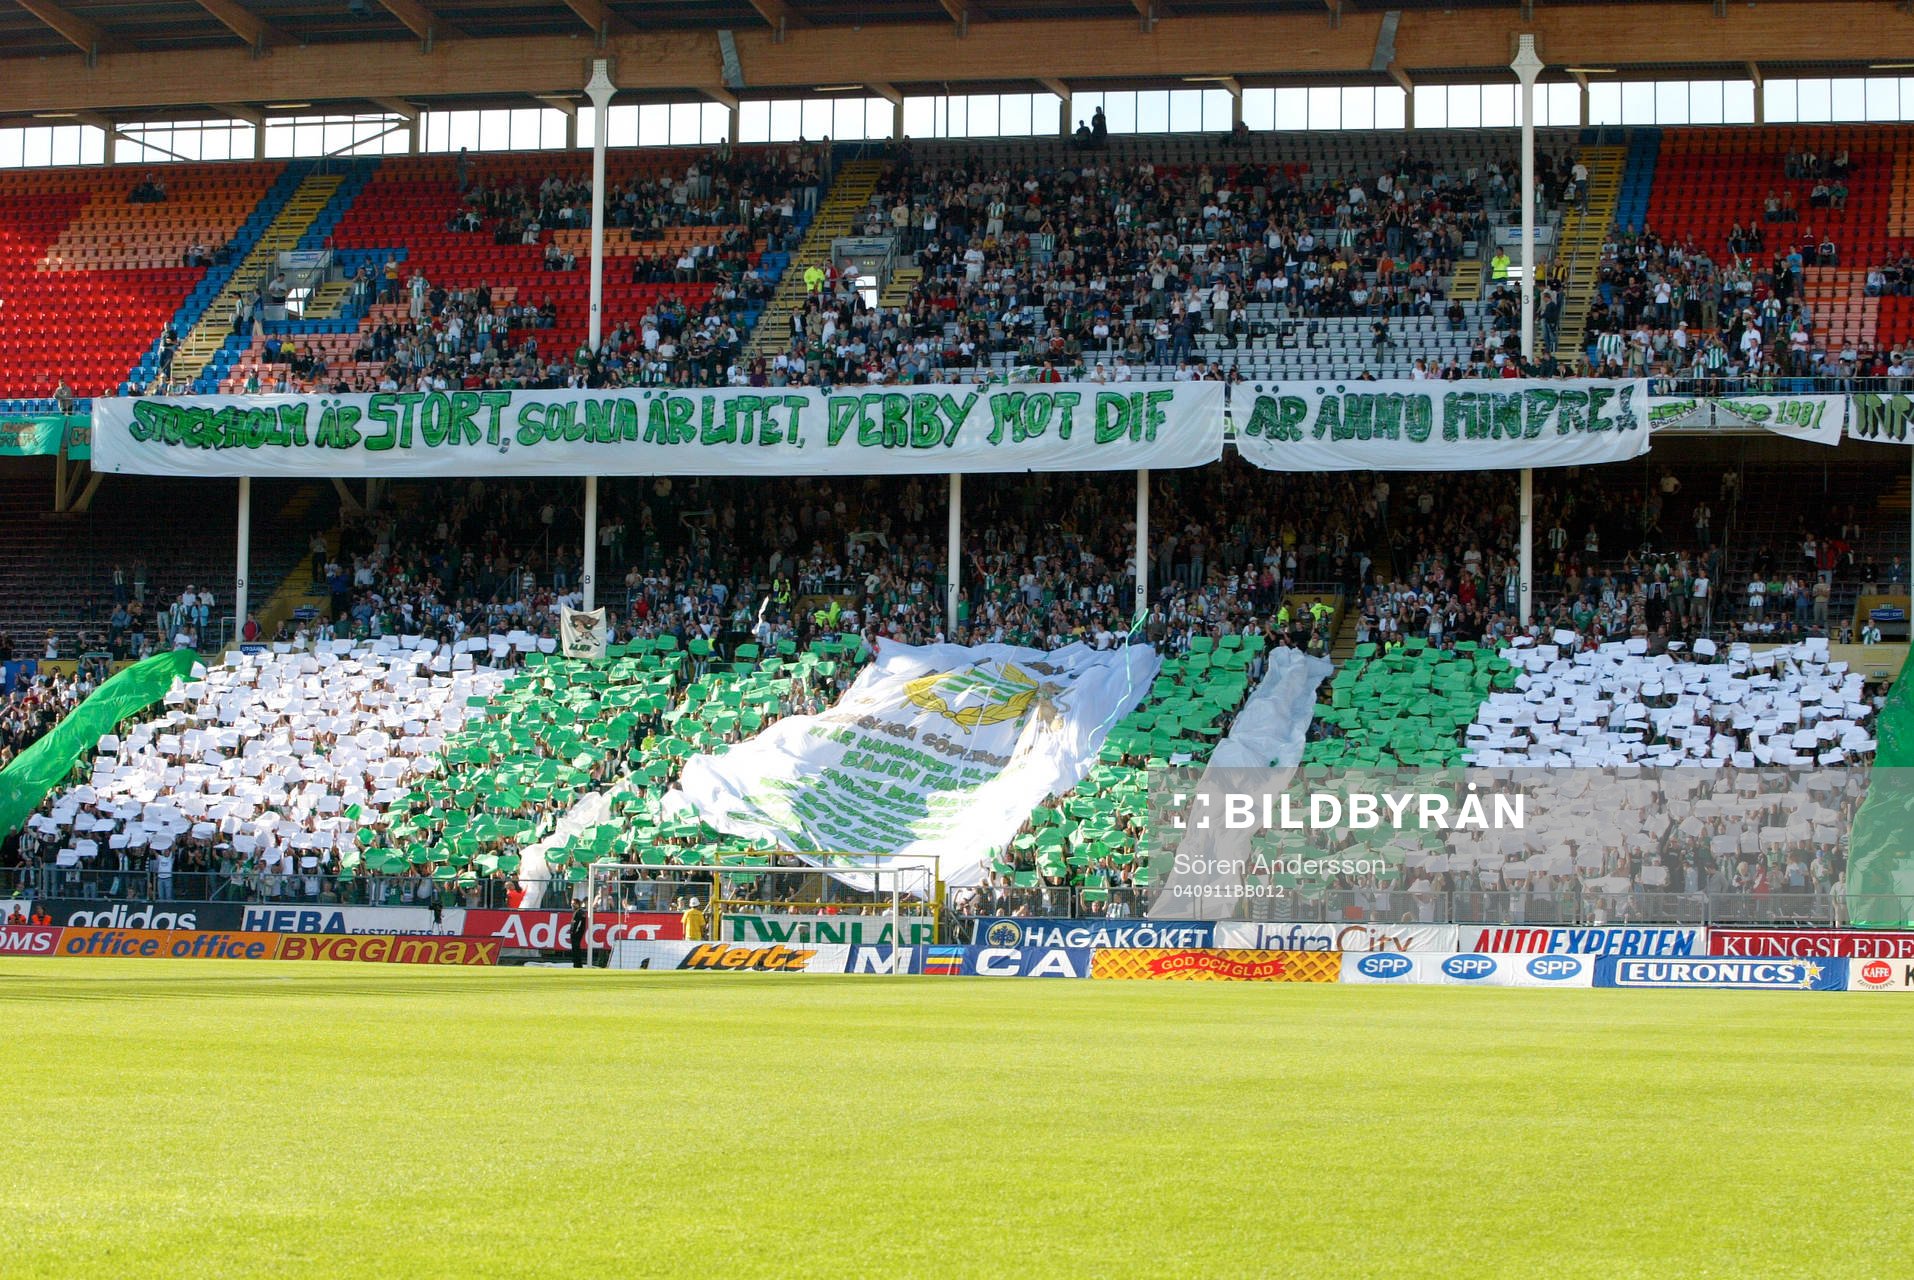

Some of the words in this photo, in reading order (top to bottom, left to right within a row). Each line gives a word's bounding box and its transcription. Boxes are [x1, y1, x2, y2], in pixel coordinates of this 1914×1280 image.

[1523, 294, 1530, 305] 3
[129, 399, 309, 451] STOCKHOLM
[314, 399, 362, 449] ÄR
[516, 398, 638, 447] SOLNA
[643, 390, 698, 445] ÄR
[986, 391, 1082, 447] MOT
[1094, 388, 1174, 445] DIF
[1245, 384, 1308, 443] ÄR
[1311, 384, 1433, 443] ÄNNU
[1774, 400, 1827, 430] 1981
[237, 578, 244, 589] 9
[584, 574, 591, 585] 8
[949, 583, 956, 593] 7
[1136, 584, 1144, 595] 6
[1521, 582, 1528, 592] 5
[68, 904, 197, 931] adidas
[245, 910, 346, 934] HEBA
[490, 914, 661, 950] Adecco
[721, 914, 934, 945] TWINLAB
[1023, 923, 1209, 949] HAGAKÖKET
[66, 931, 160, 957] office
[171, 934, 266, 960] office
[1473, 928, 1697, 957] AUTOEXPERTEN
[687, 943, 817, 971] Hertz
[1161, 955, 1196, 971] GOD
[1198, 956, 1230, 972] OCH
[1232, 962, 1275, 977] GLAD
[1363, 958, 1407, 973] SPP
[1449, 960, 1492, 974] SPP
[1533, 960, 1577, 975] SPP
[1628, 963, 1796, 982] EURONICS
[1863, 967, 1891, 979] KAFFE
